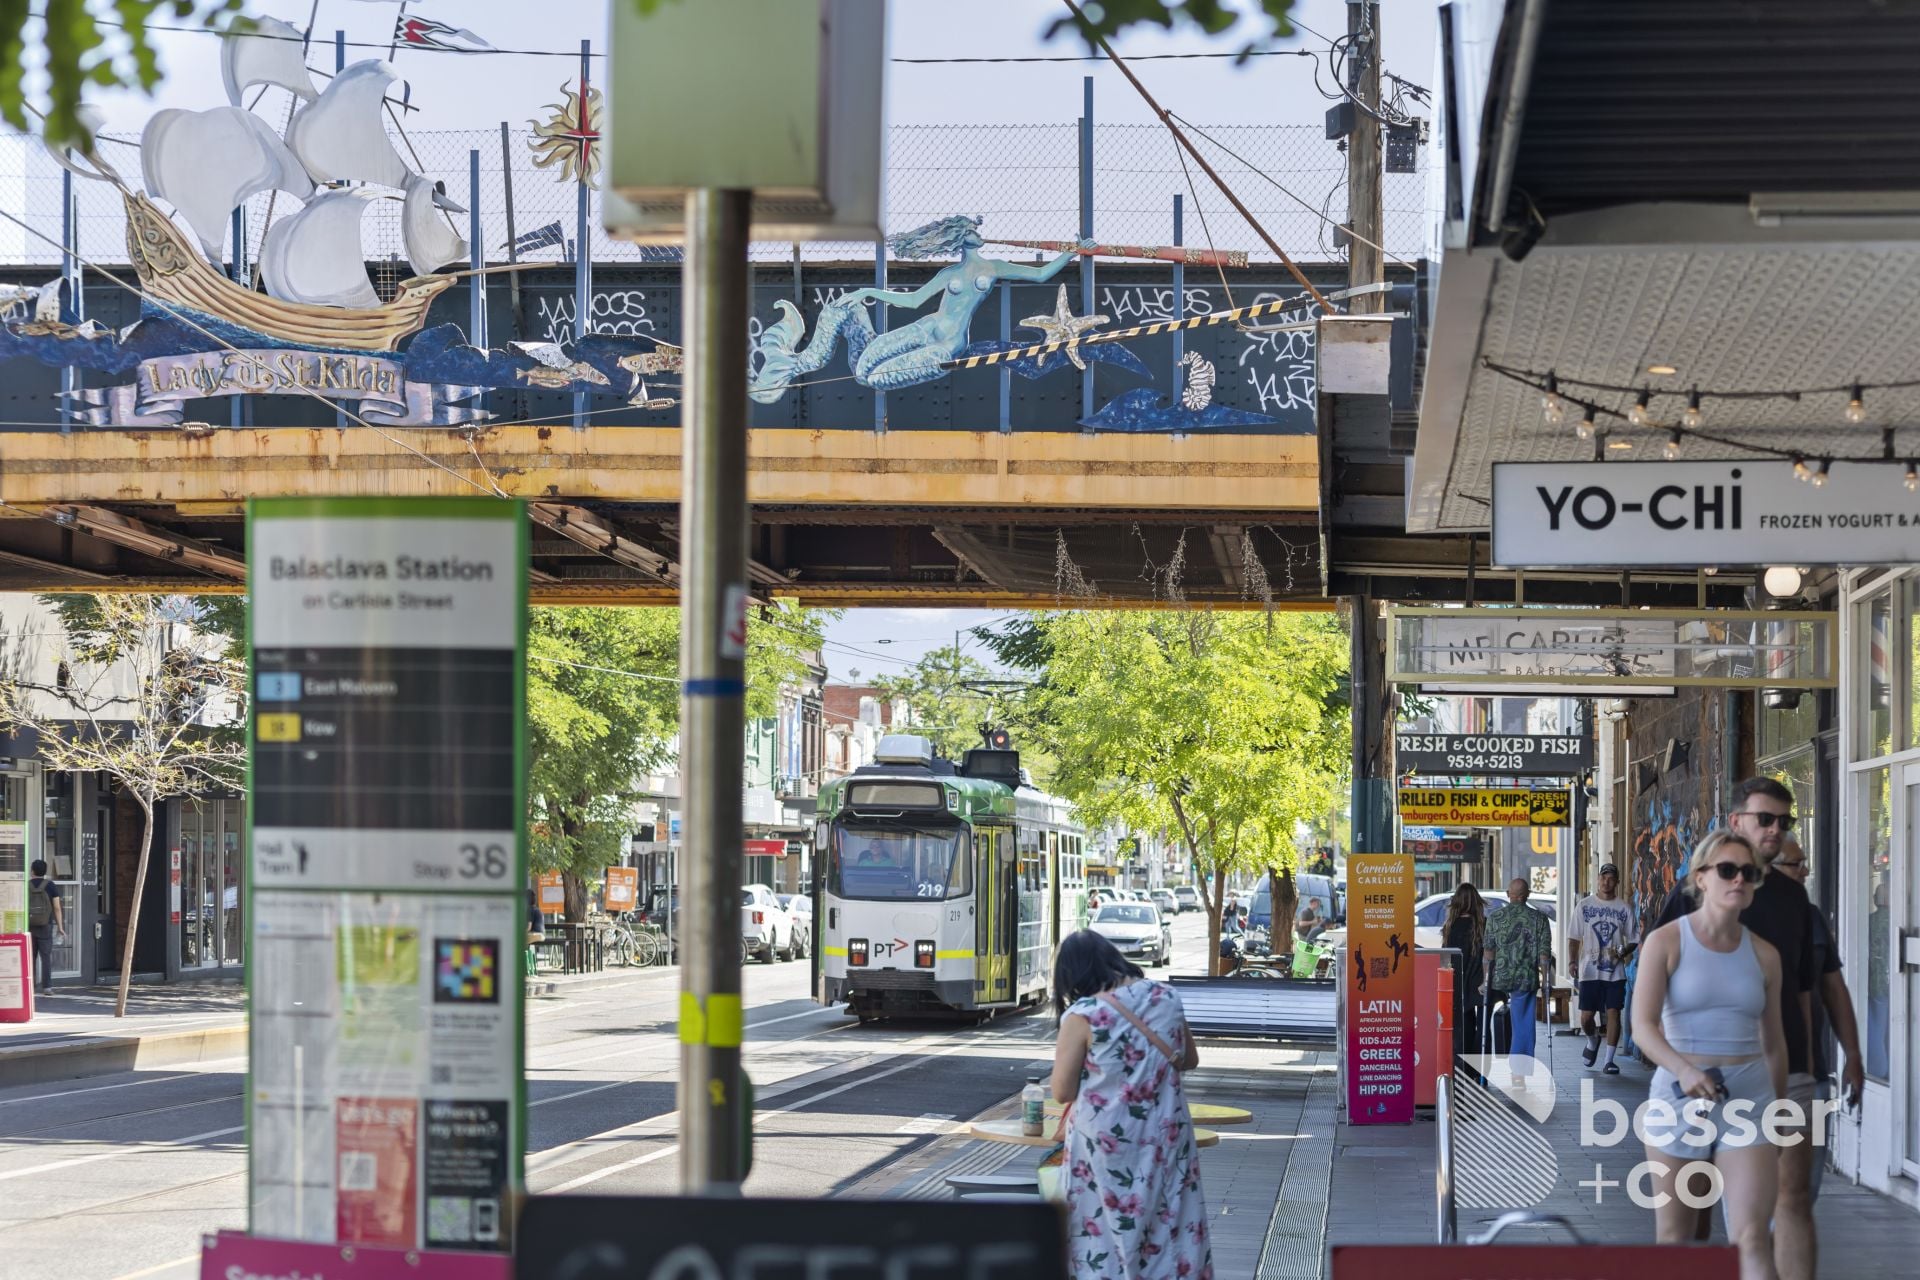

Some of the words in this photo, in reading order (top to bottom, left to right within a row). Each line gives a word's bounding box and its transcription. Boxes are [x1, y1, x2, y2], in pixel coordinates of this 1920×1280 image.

[146, 358, 224, 396] Lady
[1760, 515, 1822, 529] FROZEN
[1828, 514, 1893, 528] YOGURT
[1898, 514, 1908, 527] &
[270, 556, 388, 580] Balaclava
[397, 556, 494, 581] Station
[398, 592, 453, 609] Street
[304, 679, 337, 695] East
[304, 720, 337, 735] Kew
[1399, 737, 1447, 752] RESH
[1464, 737, 1534, 754] COOKED
[1541, 738, 1580, 754] FISH
[1400, 793, 1445, 806] RILLED
[1451, 793, 1478, 806] FISH
[1481, 797, 1489, 806] &
[1492, 793, 1529, 807] CHIPS
[1531, 792, 1568, 800] FRESH
[1533, 800, 1564, 808] FISH
[1451, 809, 1490, 822] Oysters
[1492, 810, 1529, 824] Crayfish
[917, 884, 943, 897] 219
[1364, 895, 1395, 904] HERE
[950, 911, 961, 921] 219
[1359, 1000, 1402, 1013] LATIN
[1360, 1049, 1402, 1060] GREEK
[1360, 1085, 1377, 1095] HIP
[1379, 1085, 1402, 1095] HOP
